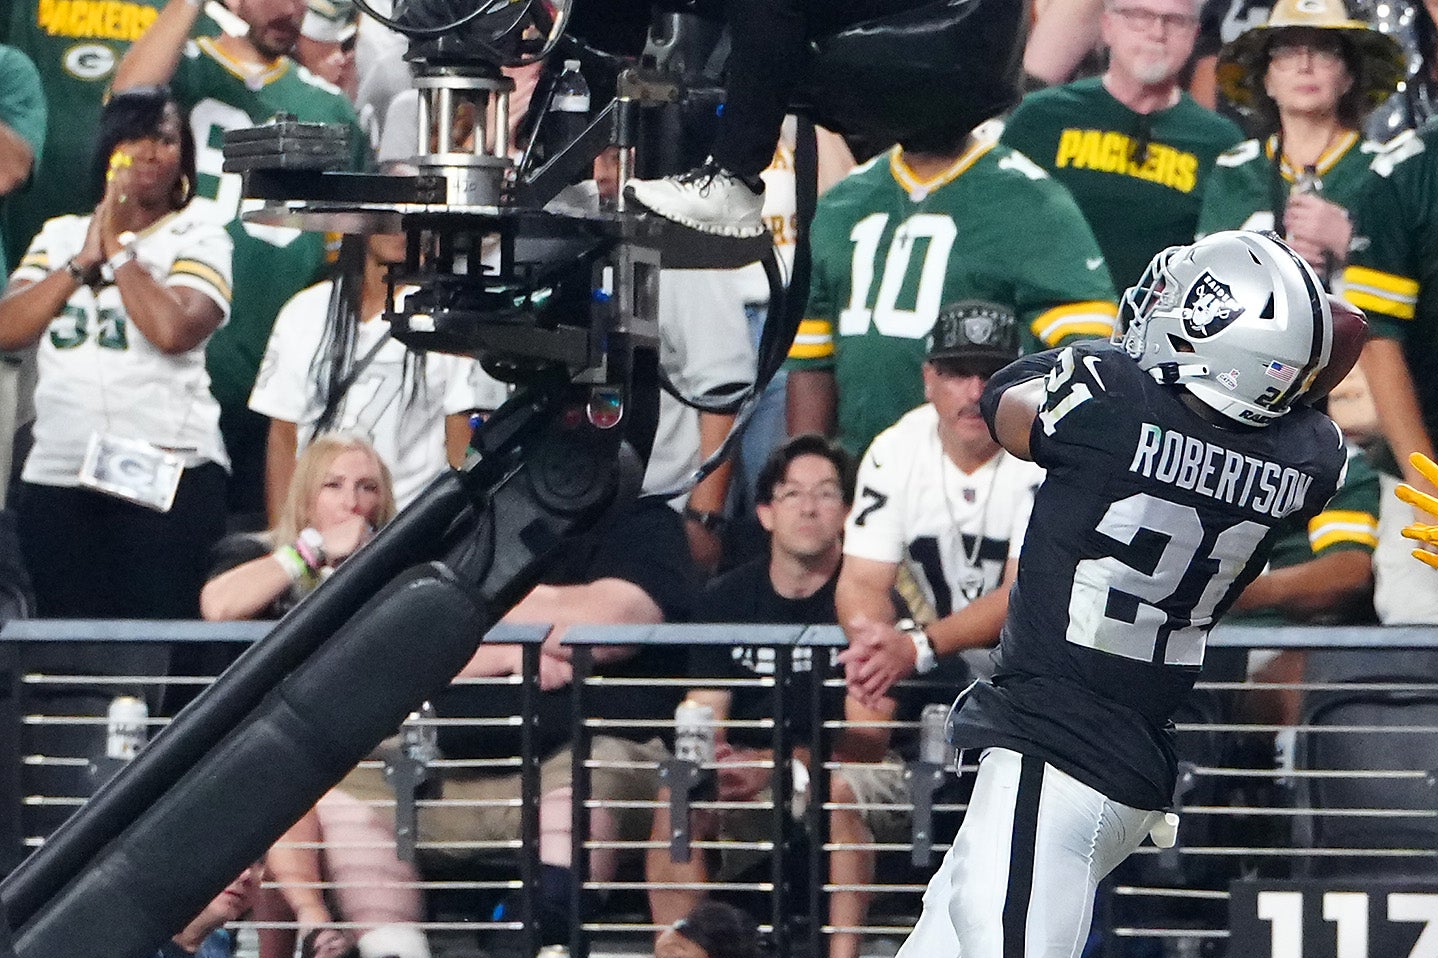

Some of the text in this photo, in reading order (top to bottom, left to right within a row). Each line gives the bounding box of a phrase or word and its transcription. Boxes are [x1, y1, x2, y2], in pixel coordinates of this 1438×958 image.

[839, 212, 958, 339] 10
[1039, 347, 1094, 437] 21
[855, 486, 887, 526] 7
[1129, 422, 1314, 518] ROBERTSON
[1065, 492, 1270, 667] 21
